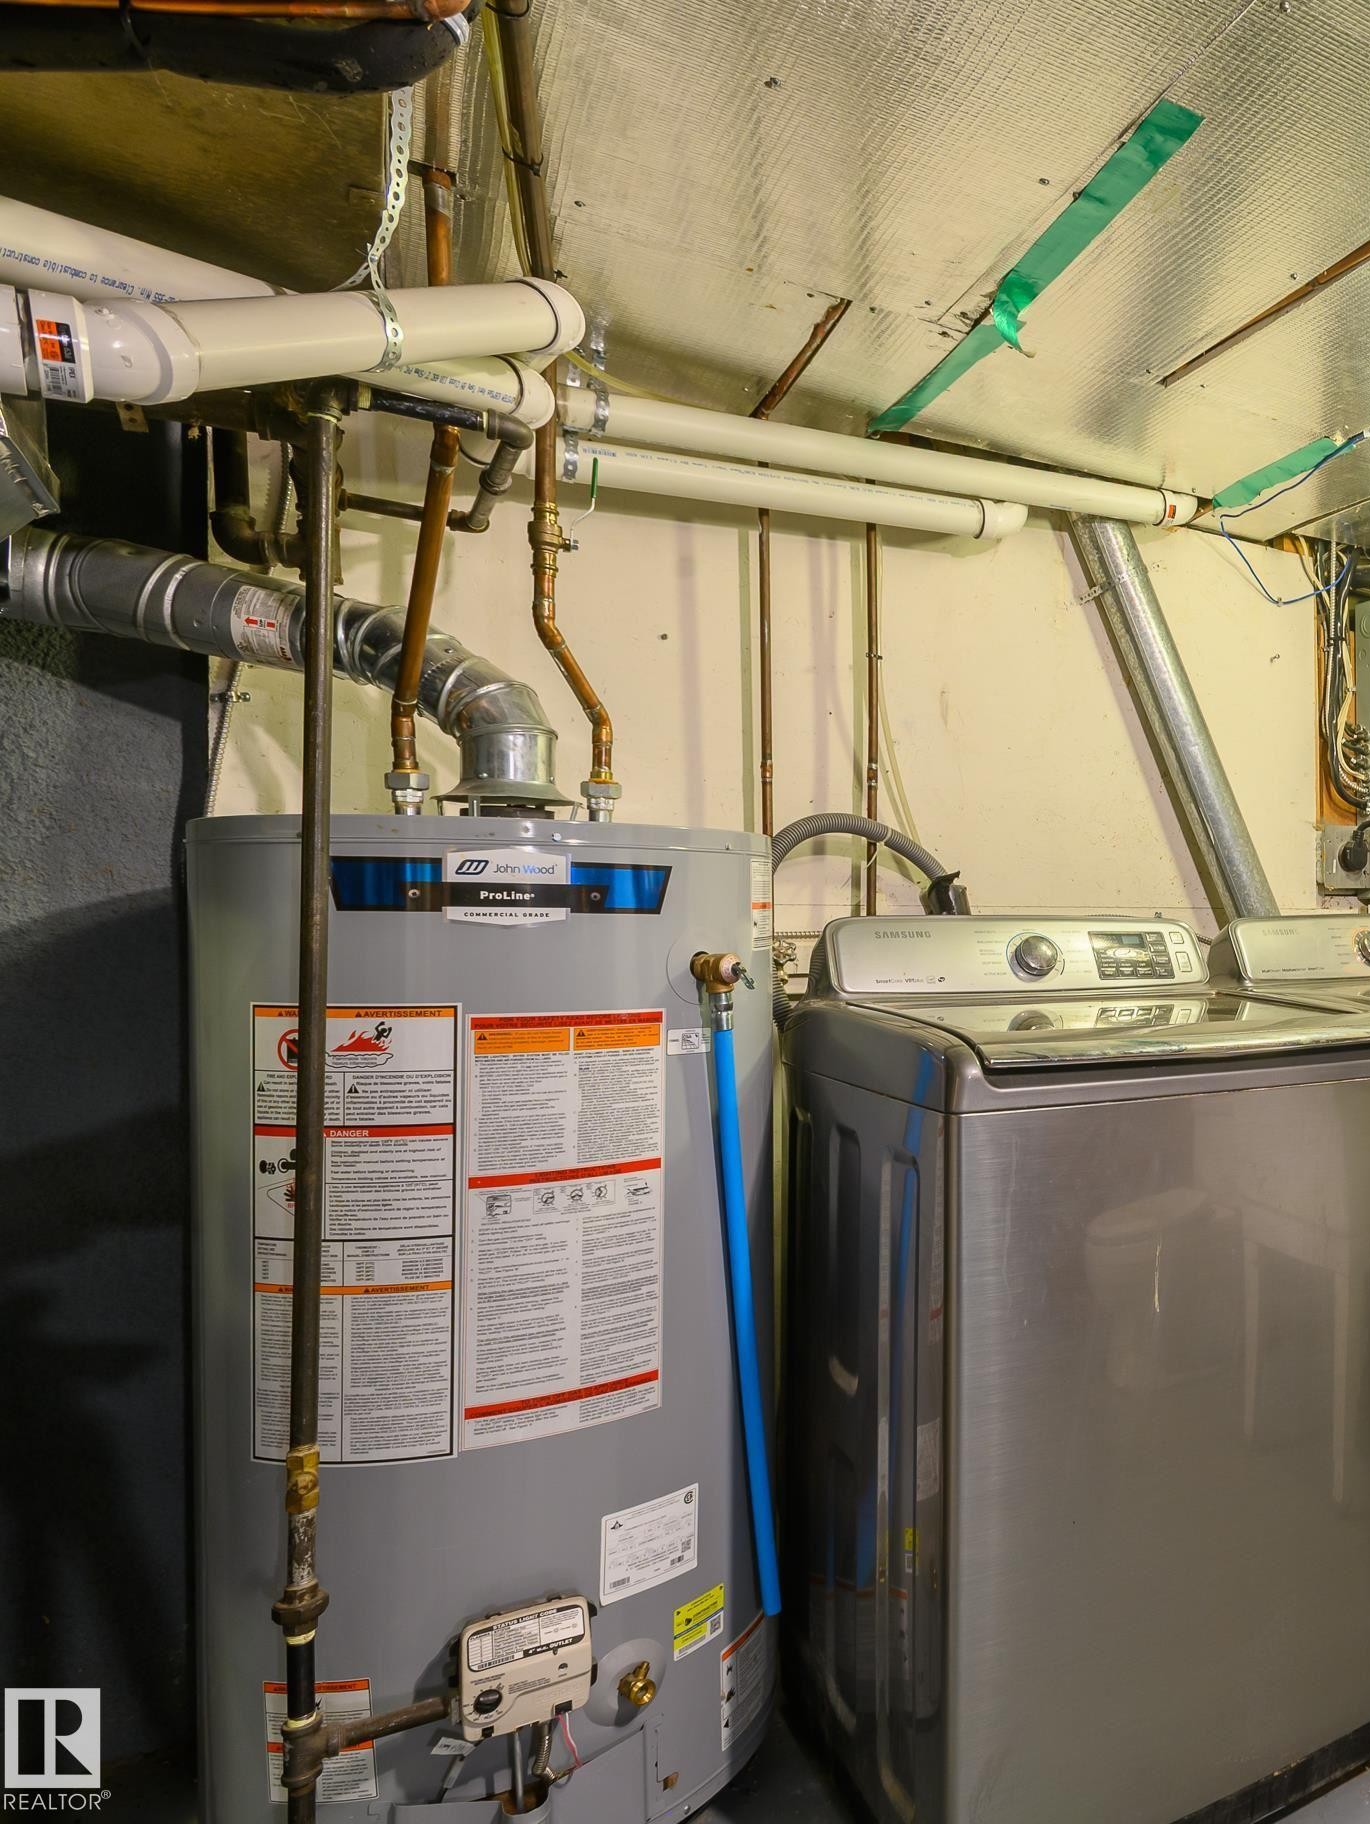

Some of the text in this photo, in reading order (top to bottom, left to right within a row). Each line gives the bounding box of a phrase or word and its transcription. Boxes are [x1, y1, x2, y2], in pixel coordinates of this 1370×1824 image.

[90, 273, 98, 283] to
[493, 864, 555, 874] John Wood
[874, 931, 932, 939] SAMSUNG
[363, 1010, 442, 1018] AVERTISSEMENT
[370, 1285, 429, 1293] AVERTISSEMENT
[493, 1608, 557, 1630] STATUS LIGHT CODE
[549, 1638, 573, 1648] OUTLET
